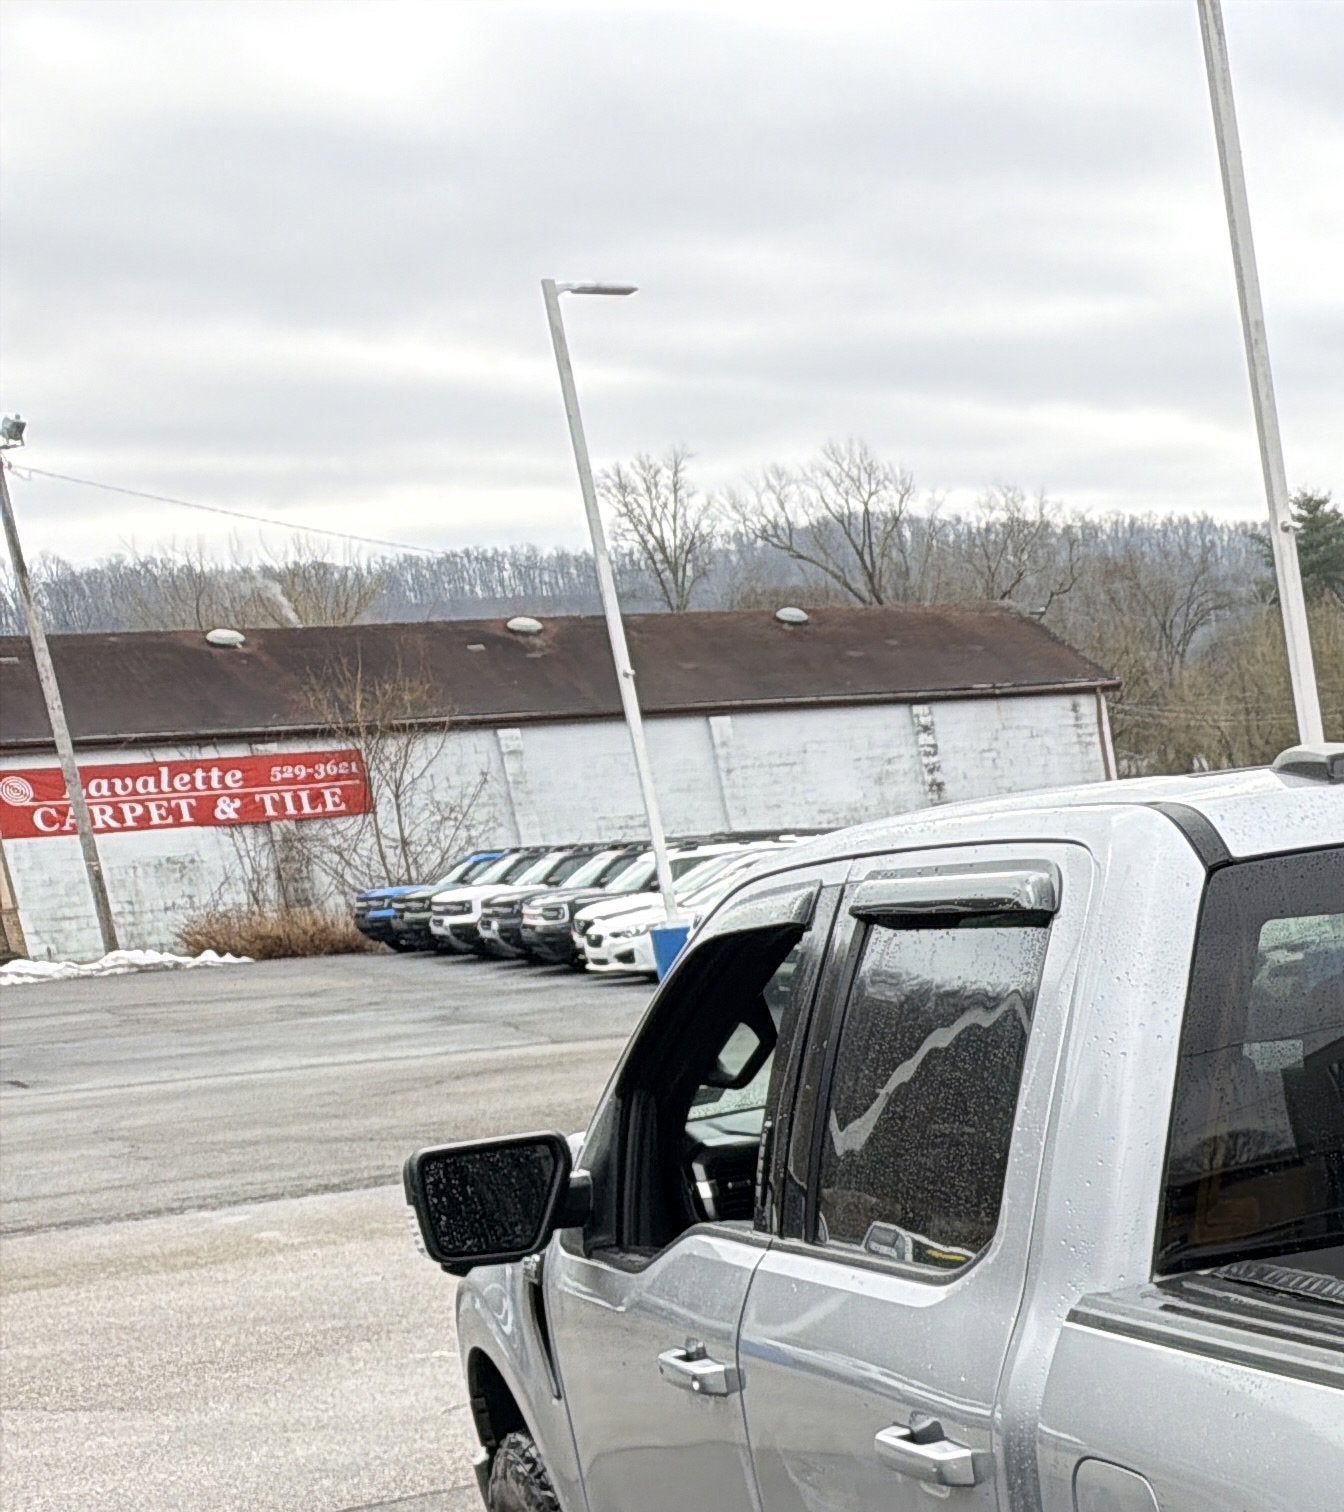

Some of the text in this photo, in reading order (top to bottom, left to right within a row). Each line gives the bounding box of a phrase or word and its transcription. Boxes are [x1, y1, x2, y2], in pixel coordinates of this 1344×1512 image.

[270, 759, 359, 782] 529-3621
[214, 796, 241, 821] &
[255, 786, 347, 818] TILE
